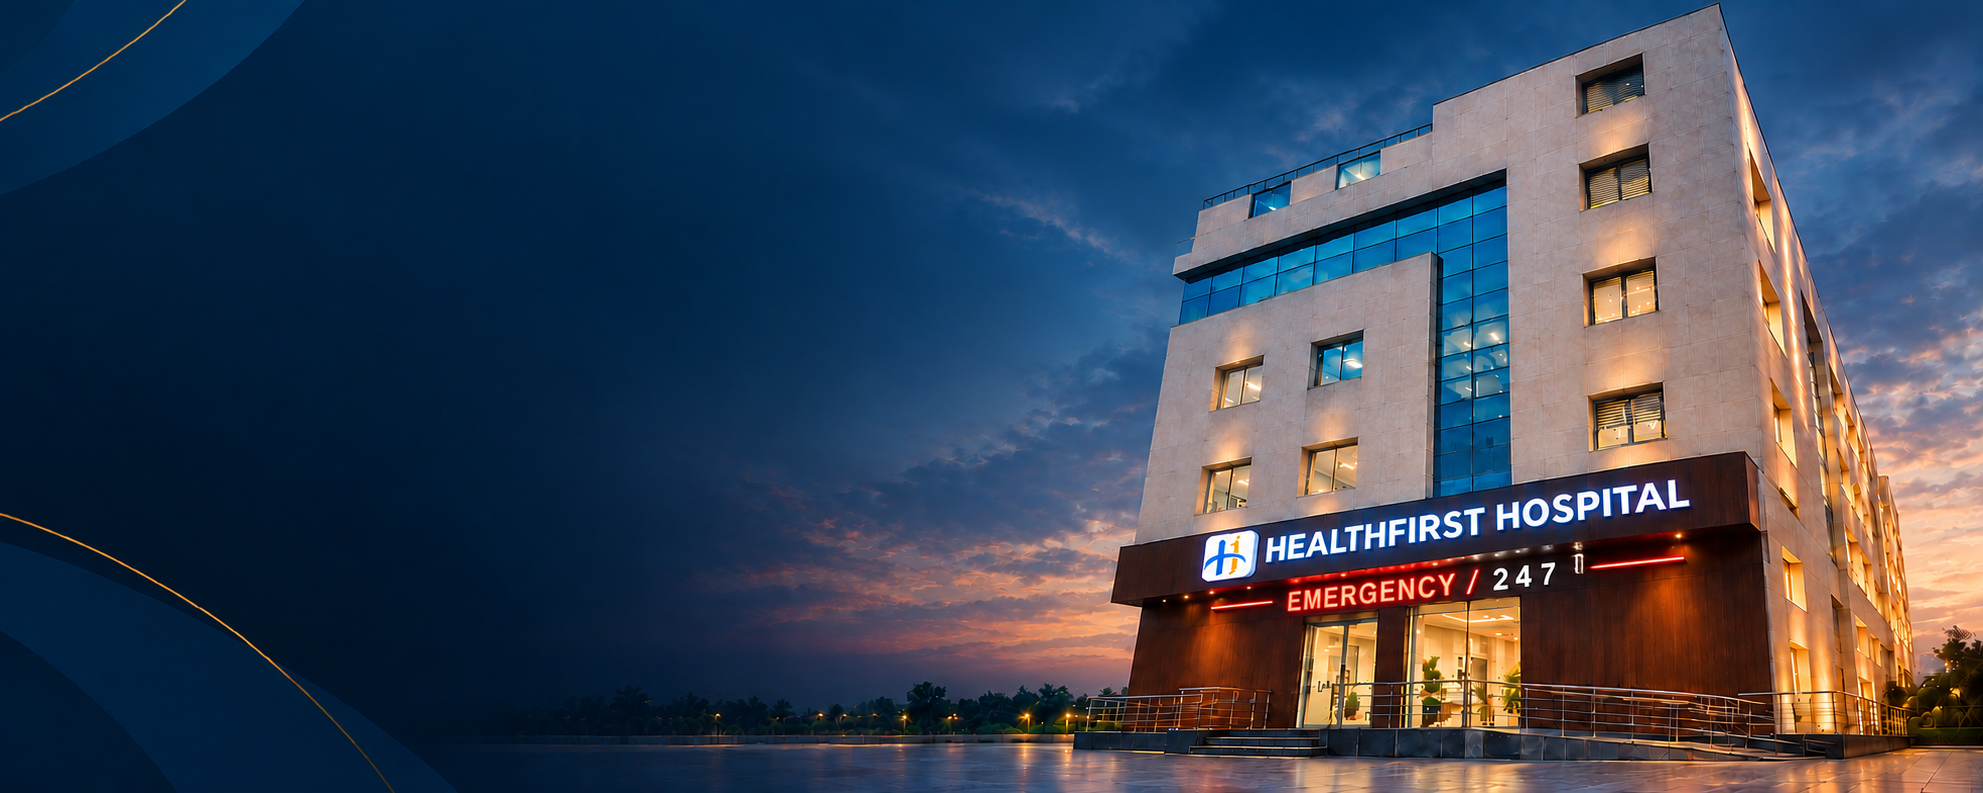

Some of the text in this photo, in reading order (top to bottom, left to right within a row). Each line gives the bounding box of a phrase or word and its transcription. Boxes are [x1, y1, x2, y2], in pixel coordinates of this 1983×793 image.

[1265, 479, 1690, 563] HEALTHFIRST HOSPITAL
[1287, 573, 1455, 612] EMERGENCY
[1492, 562, 1556, 591] 247
